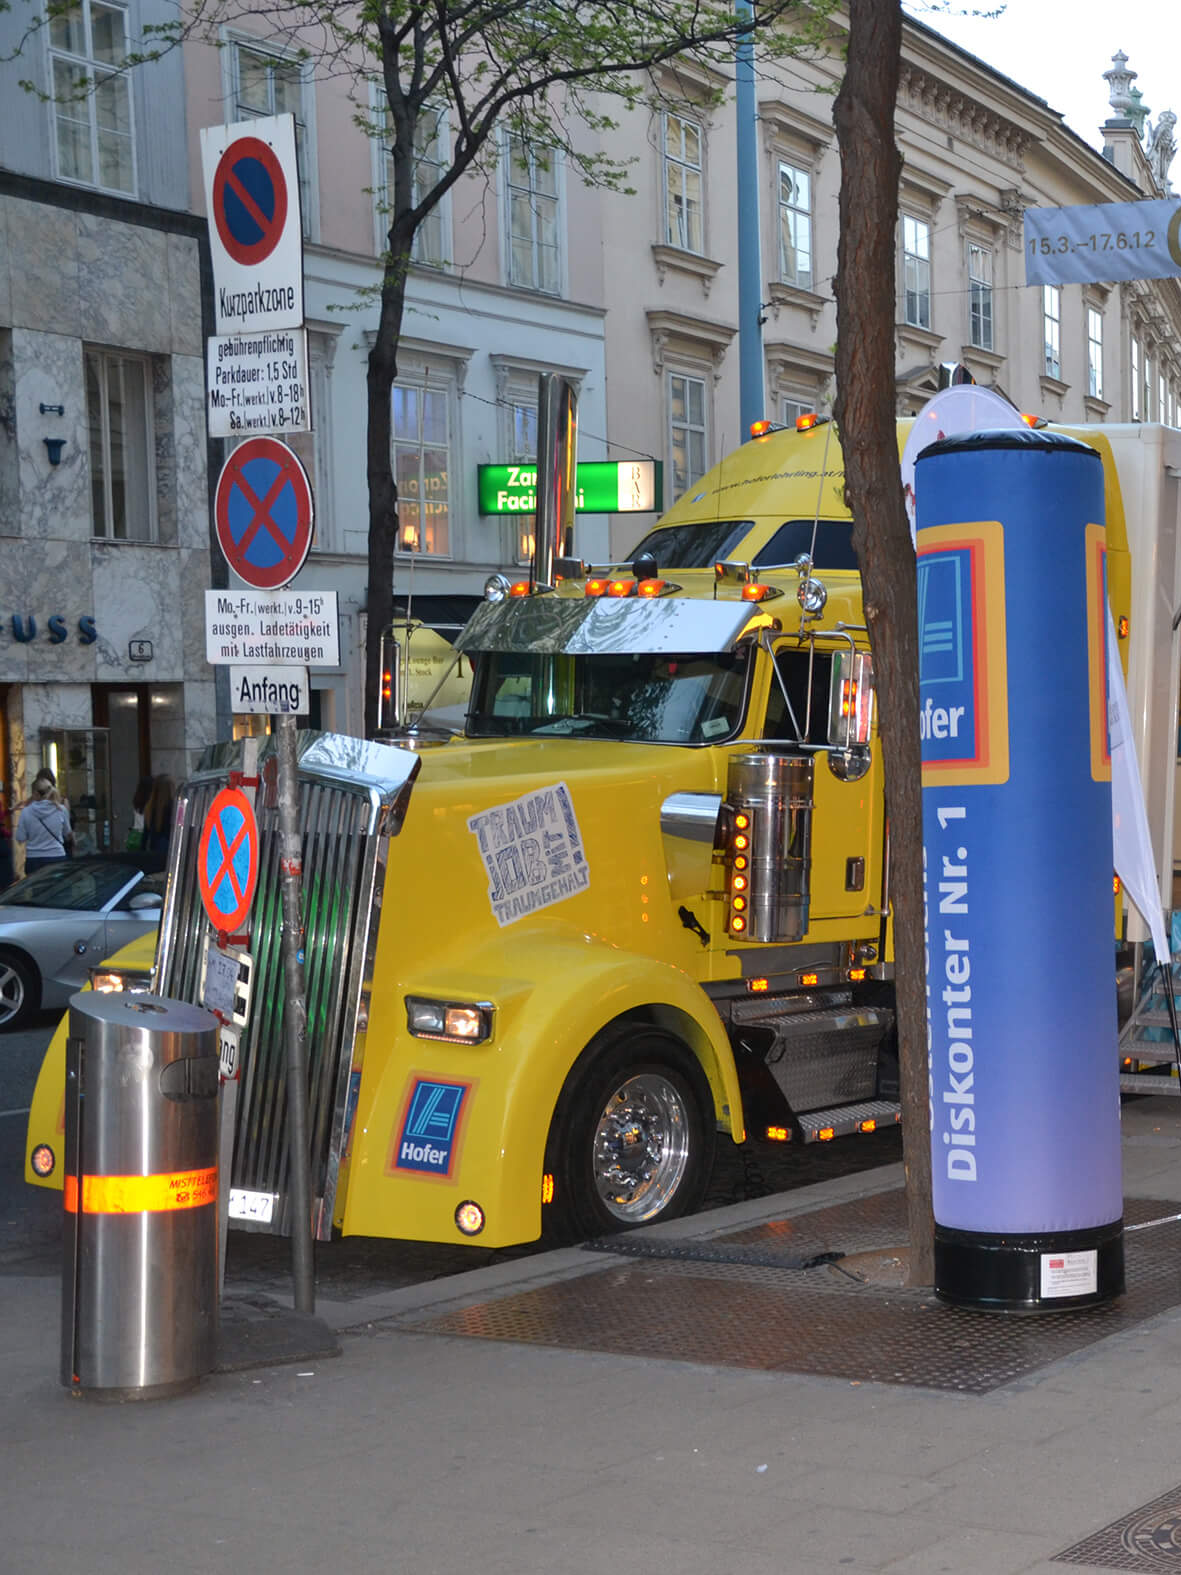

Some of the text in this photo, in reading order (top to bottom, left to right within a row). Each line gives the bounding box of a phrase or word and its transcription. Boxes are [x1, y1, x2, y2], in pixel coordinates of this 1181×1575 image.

[219, 282, 295, 323] Kurzparkzone
[218, 335, 294, 362] gebührenpflichtig
[216, 360, 297, 385] Parkdauer: 1,5 Std
[212, 621, 330, 640] ausgen. Ladetätigkeit
[221, 642, 324, 661] mit Lastfahrzeugen
[240, 676, 300, 710] Anfang
[469, 791, 558, 853] TRAUM
[493, 865, 589, 923] TRAUMGEHALT
[937, 806, 978, 1182] Diskonter Nr. 1
[401, 1142, 448, 1165] Hofer
